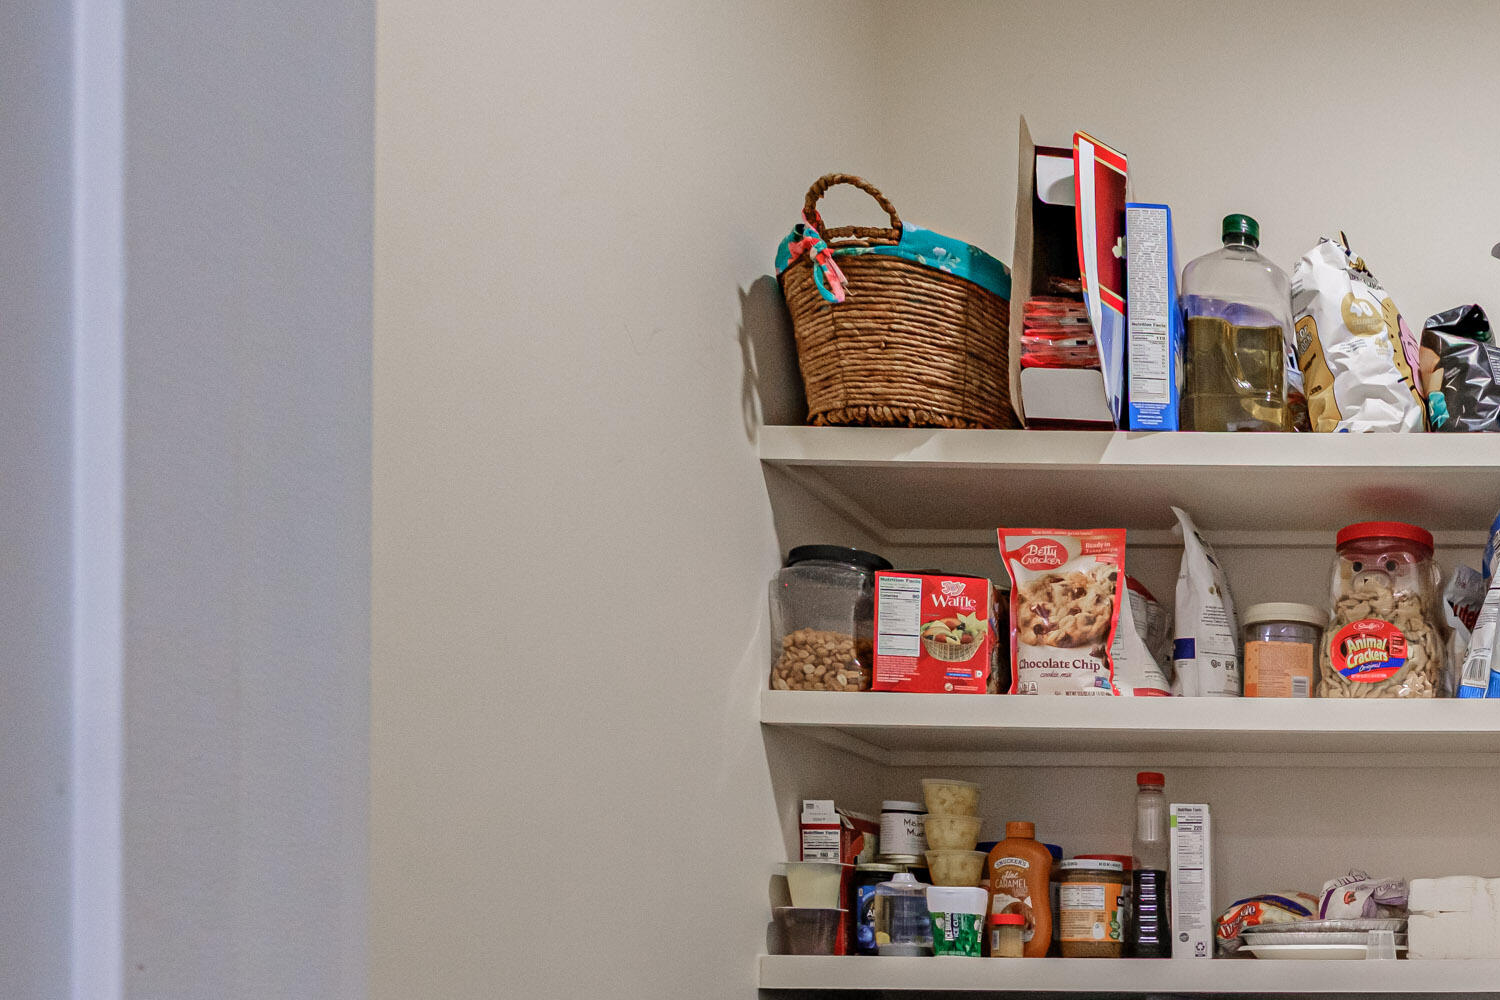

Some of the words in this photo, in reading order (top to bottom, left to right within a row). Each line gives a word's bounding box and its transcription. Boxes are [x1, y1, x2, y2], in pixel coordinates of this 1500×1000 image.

[1026, 544, 1058, 559] Betty
[1021, 555, 1063, 566] Crocker
[931, 593, 977, 608] Waffle
[1346, 633, 1388, 654] Animal
[1019, 658, 1070, 670] Chocolate
[1072, 659, 1101, 673] Chip
[1346, 648, 1389, 669] Crackers
[995, 879, 1027, 889] CARAMEL
